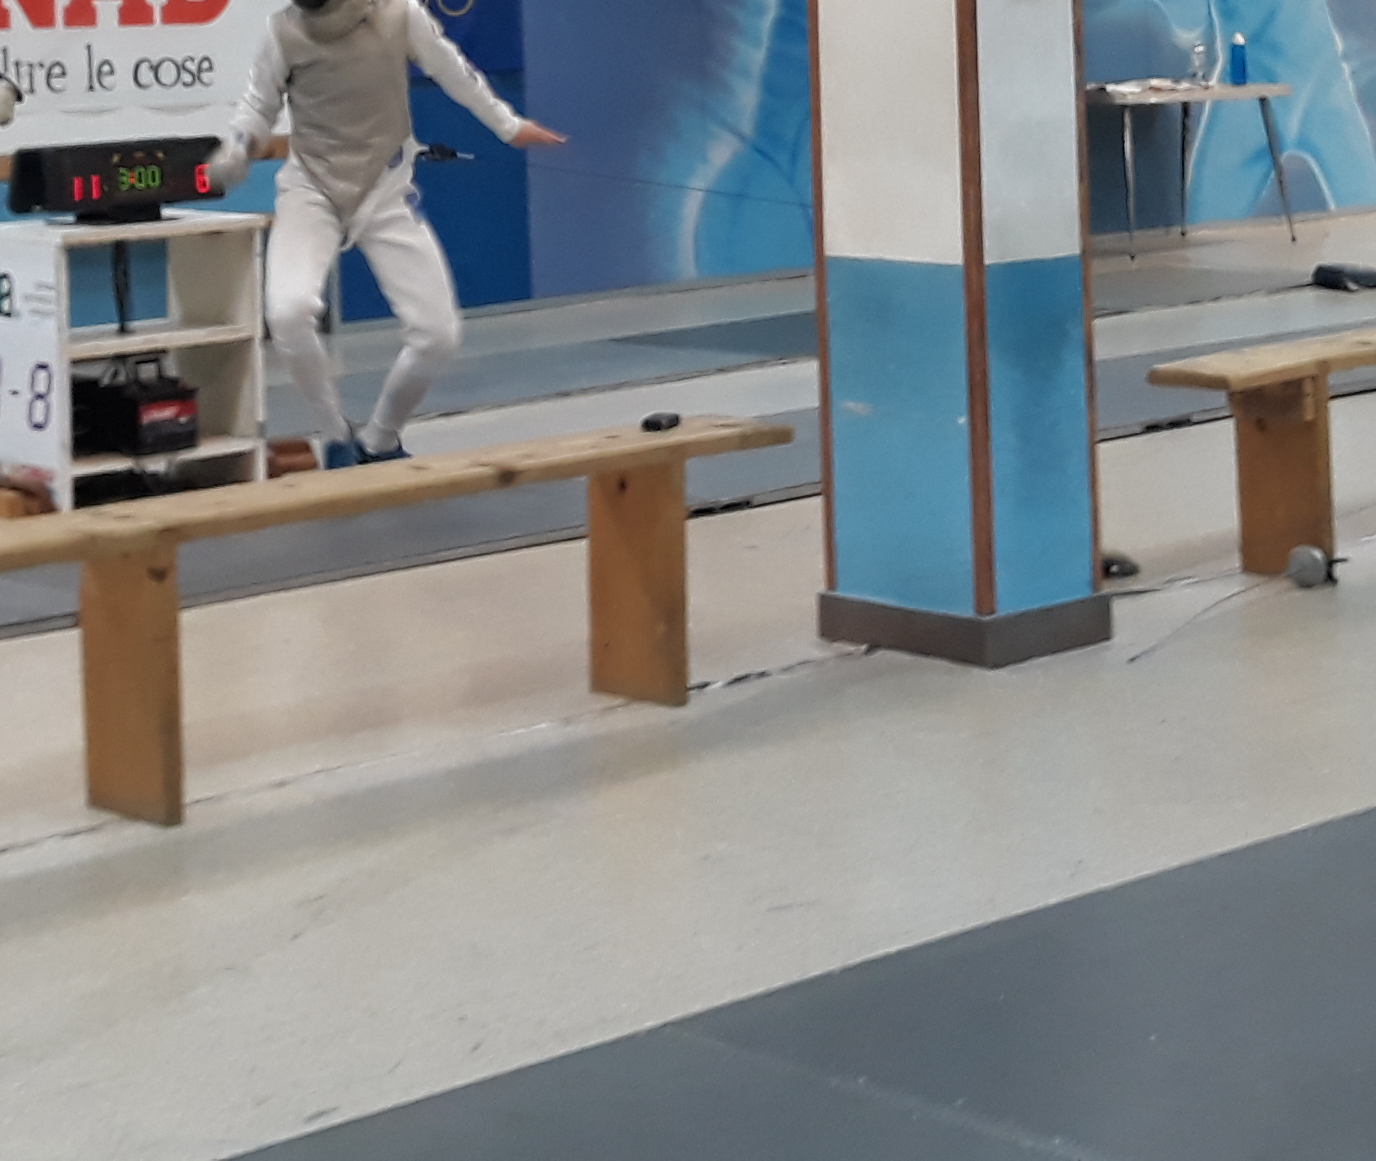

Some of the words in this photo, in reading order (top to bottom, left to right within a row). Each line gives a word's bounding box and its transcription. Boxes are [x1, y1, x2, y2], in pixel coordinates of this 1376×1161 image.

[86, 44, 118, 91] le
[133, 51, 215, 90] cose
[72, 174, 102, 201] 11
[118, 165, 162, 191] 3:00
